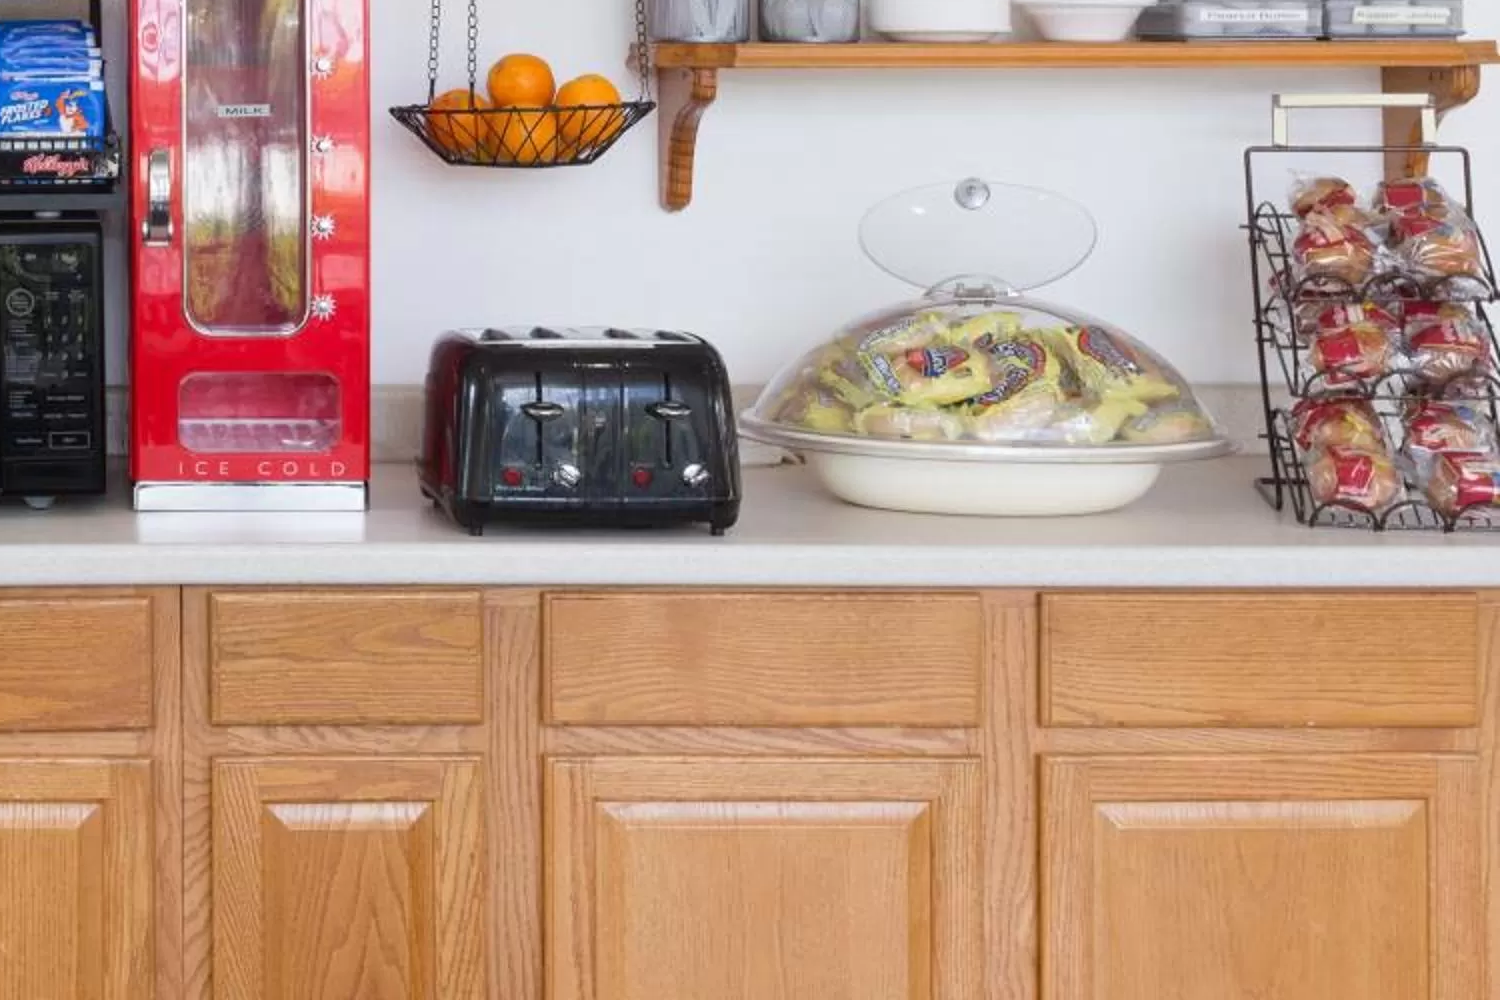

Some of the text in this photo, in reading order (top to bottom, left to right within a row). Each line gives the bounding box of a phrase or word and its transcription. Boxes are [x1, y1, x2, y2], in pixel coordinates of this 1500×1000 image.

[225, 107, 265, 115] MILK
[178, 461, 346, 477] ICE COLD
